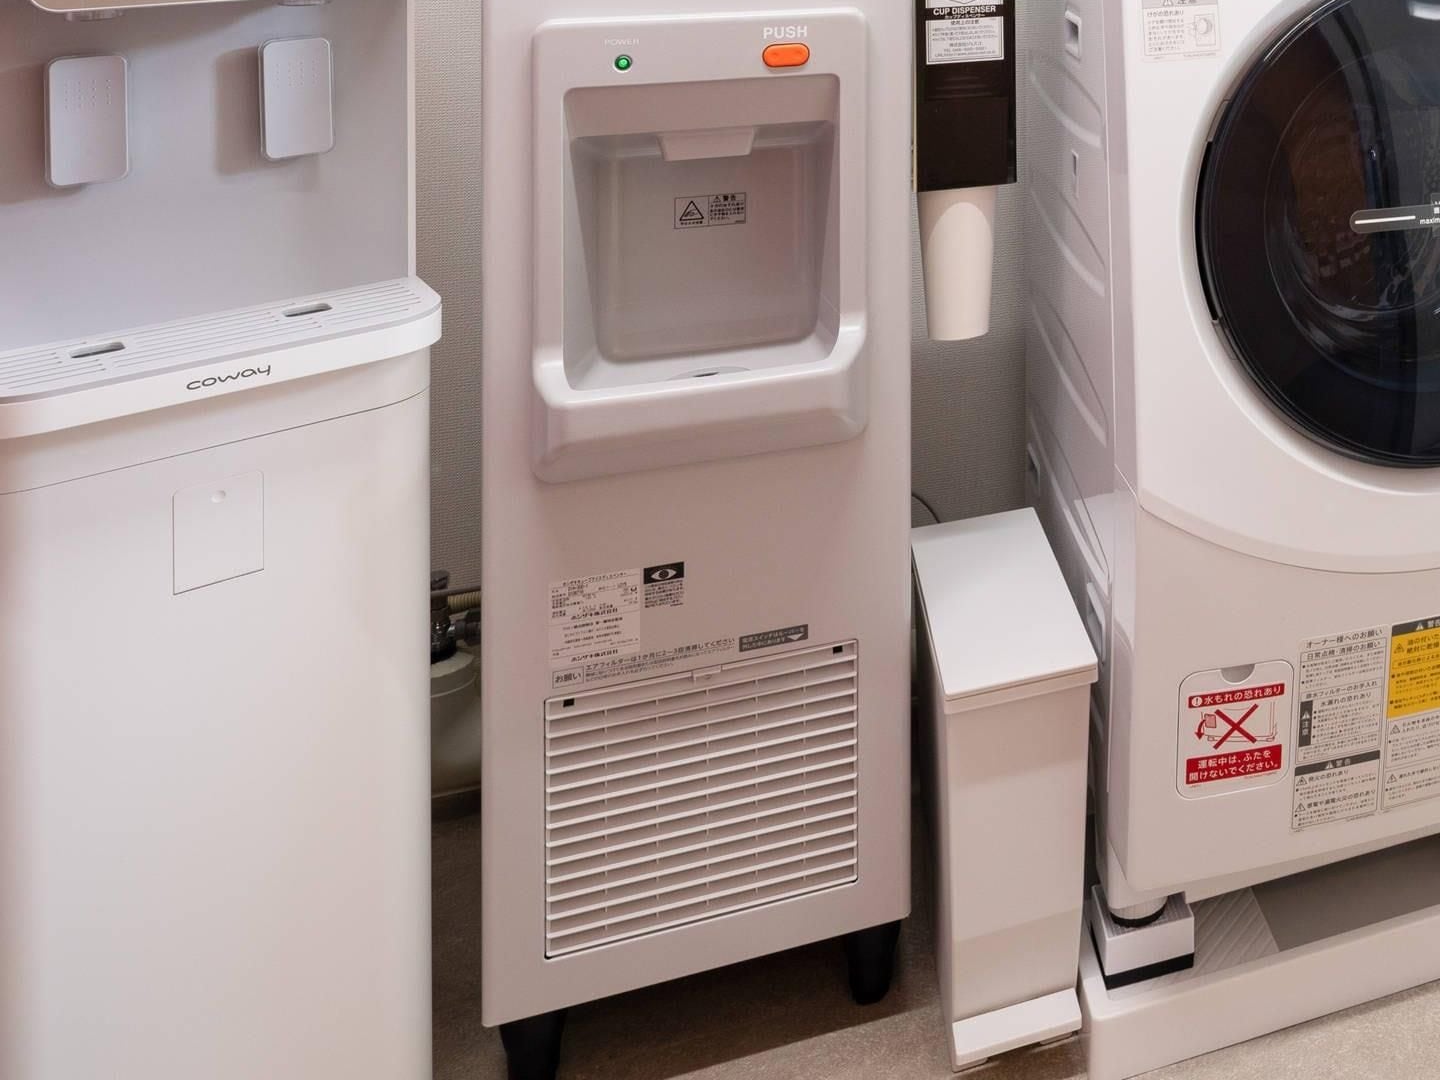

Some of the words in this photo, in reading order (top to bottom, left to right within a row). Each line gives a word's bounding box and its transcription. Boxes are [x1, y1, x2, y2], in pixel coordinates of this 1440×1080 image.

[933, 8, 950, 16] CUP
[951, 6, 996, 15] DISPENSER
[763, 25, 808, 39] PUSH
[604, 38, 640, 46] POWER
[186, 364, 271, 390] coway
[1306, 629, 1383, 649] オーナー様へのお願い
[554, 671, 582, 685] お願い
[1204, 685, 1281, 705] 水もれの恐れあり
[1305, 680, 1377, 699] 排水フィルターのお手入れ
[1321, 692, 1371, 706] 水漏れの恐れあり
[1197, 750, 1271, 769] 運転中は、ふたを
[1189, 760, 1278, 782] 開けないでください。
